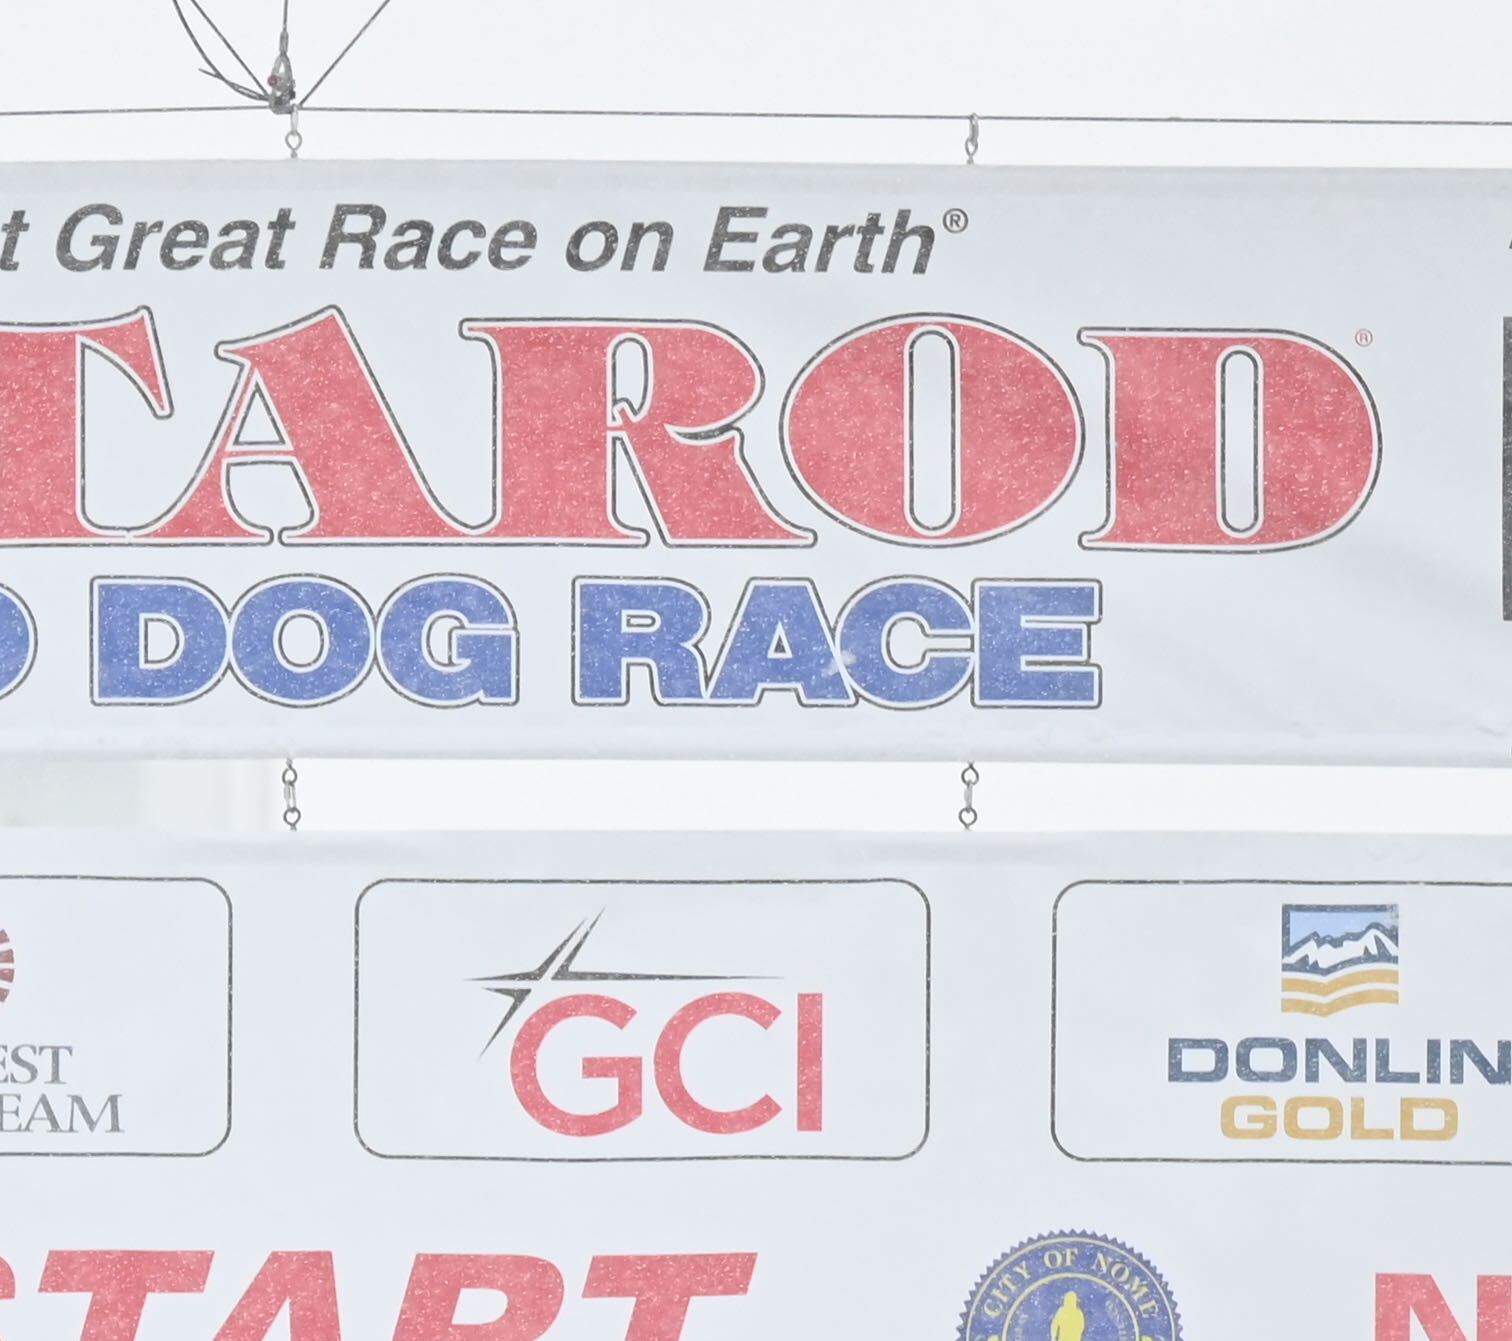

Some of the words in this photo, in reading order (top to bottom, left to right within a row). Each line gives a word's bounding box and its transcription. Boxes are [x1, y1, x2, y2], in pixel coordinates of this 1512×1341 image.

[55, 204, 295, 273] Great
[319, 203, 537, 271] Race
[566, 221, 683, 272] on
[90, 574, 519, 712] DOG
[572, 573, 1103, 709] RACE
[508, 990, 825, 1138] GCI
[1165, 1036, 1512, 1087] DONLIN
[1219, 1095, 1460, 1143] GOLD
[983, 1260, 1032, 1318] CITY
[1043, 1247, 1078, 1268] OF
[1090, 1252, 1160, 1319] NOME
